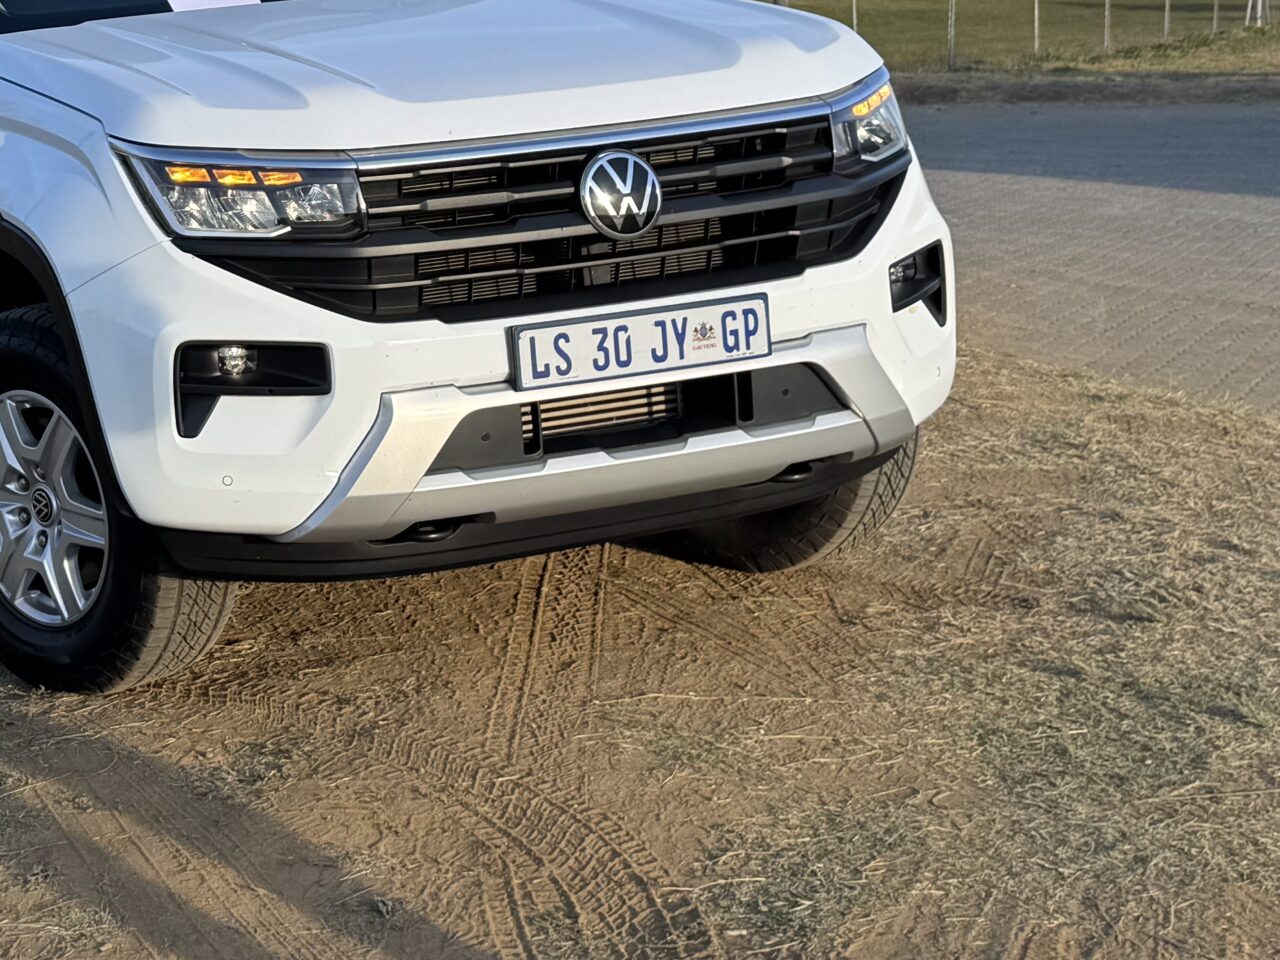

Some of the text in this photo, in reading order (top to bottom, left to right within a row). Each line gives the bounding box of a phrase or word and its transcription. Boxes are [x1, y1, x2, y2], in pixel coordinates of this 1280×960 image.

[584, 152, 659, 234] VW
[528, 307, 760, 380] LS 30 JY GP
[692, 342, 717, 351] GAUTENG
